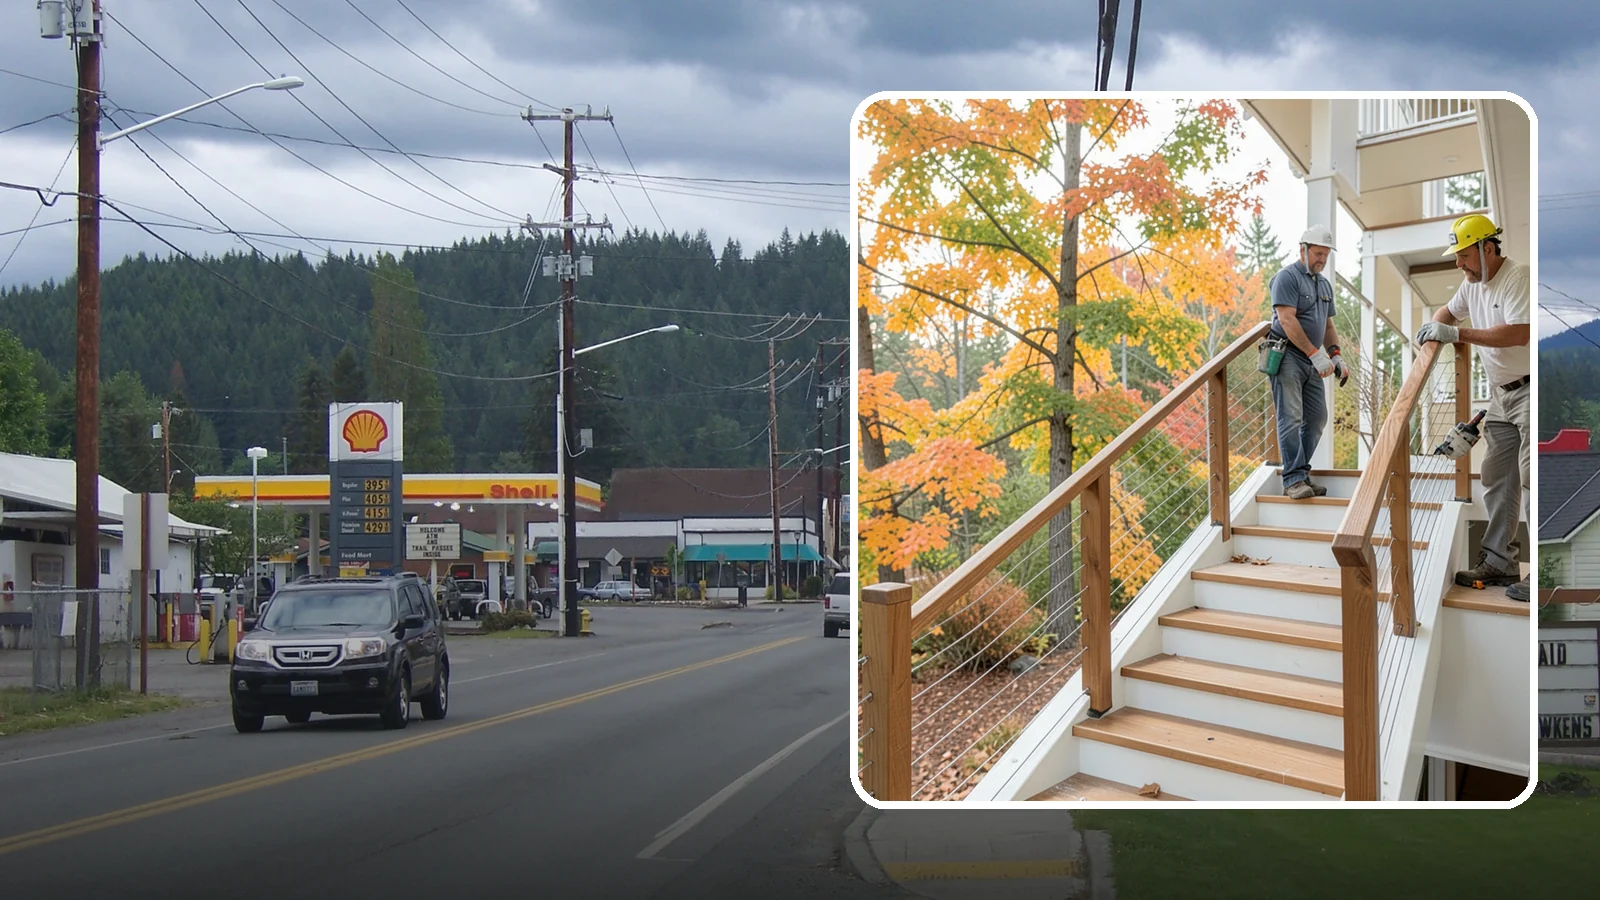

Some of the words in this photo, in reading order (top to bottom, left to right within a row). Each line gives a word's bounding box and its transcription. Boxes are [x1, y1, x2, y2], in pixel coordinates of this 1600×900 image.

[490, 484, 547, 499] Shell
[1539, 642, 1567, 665] AID
[1538, 715, 1592, 738] WKENS
